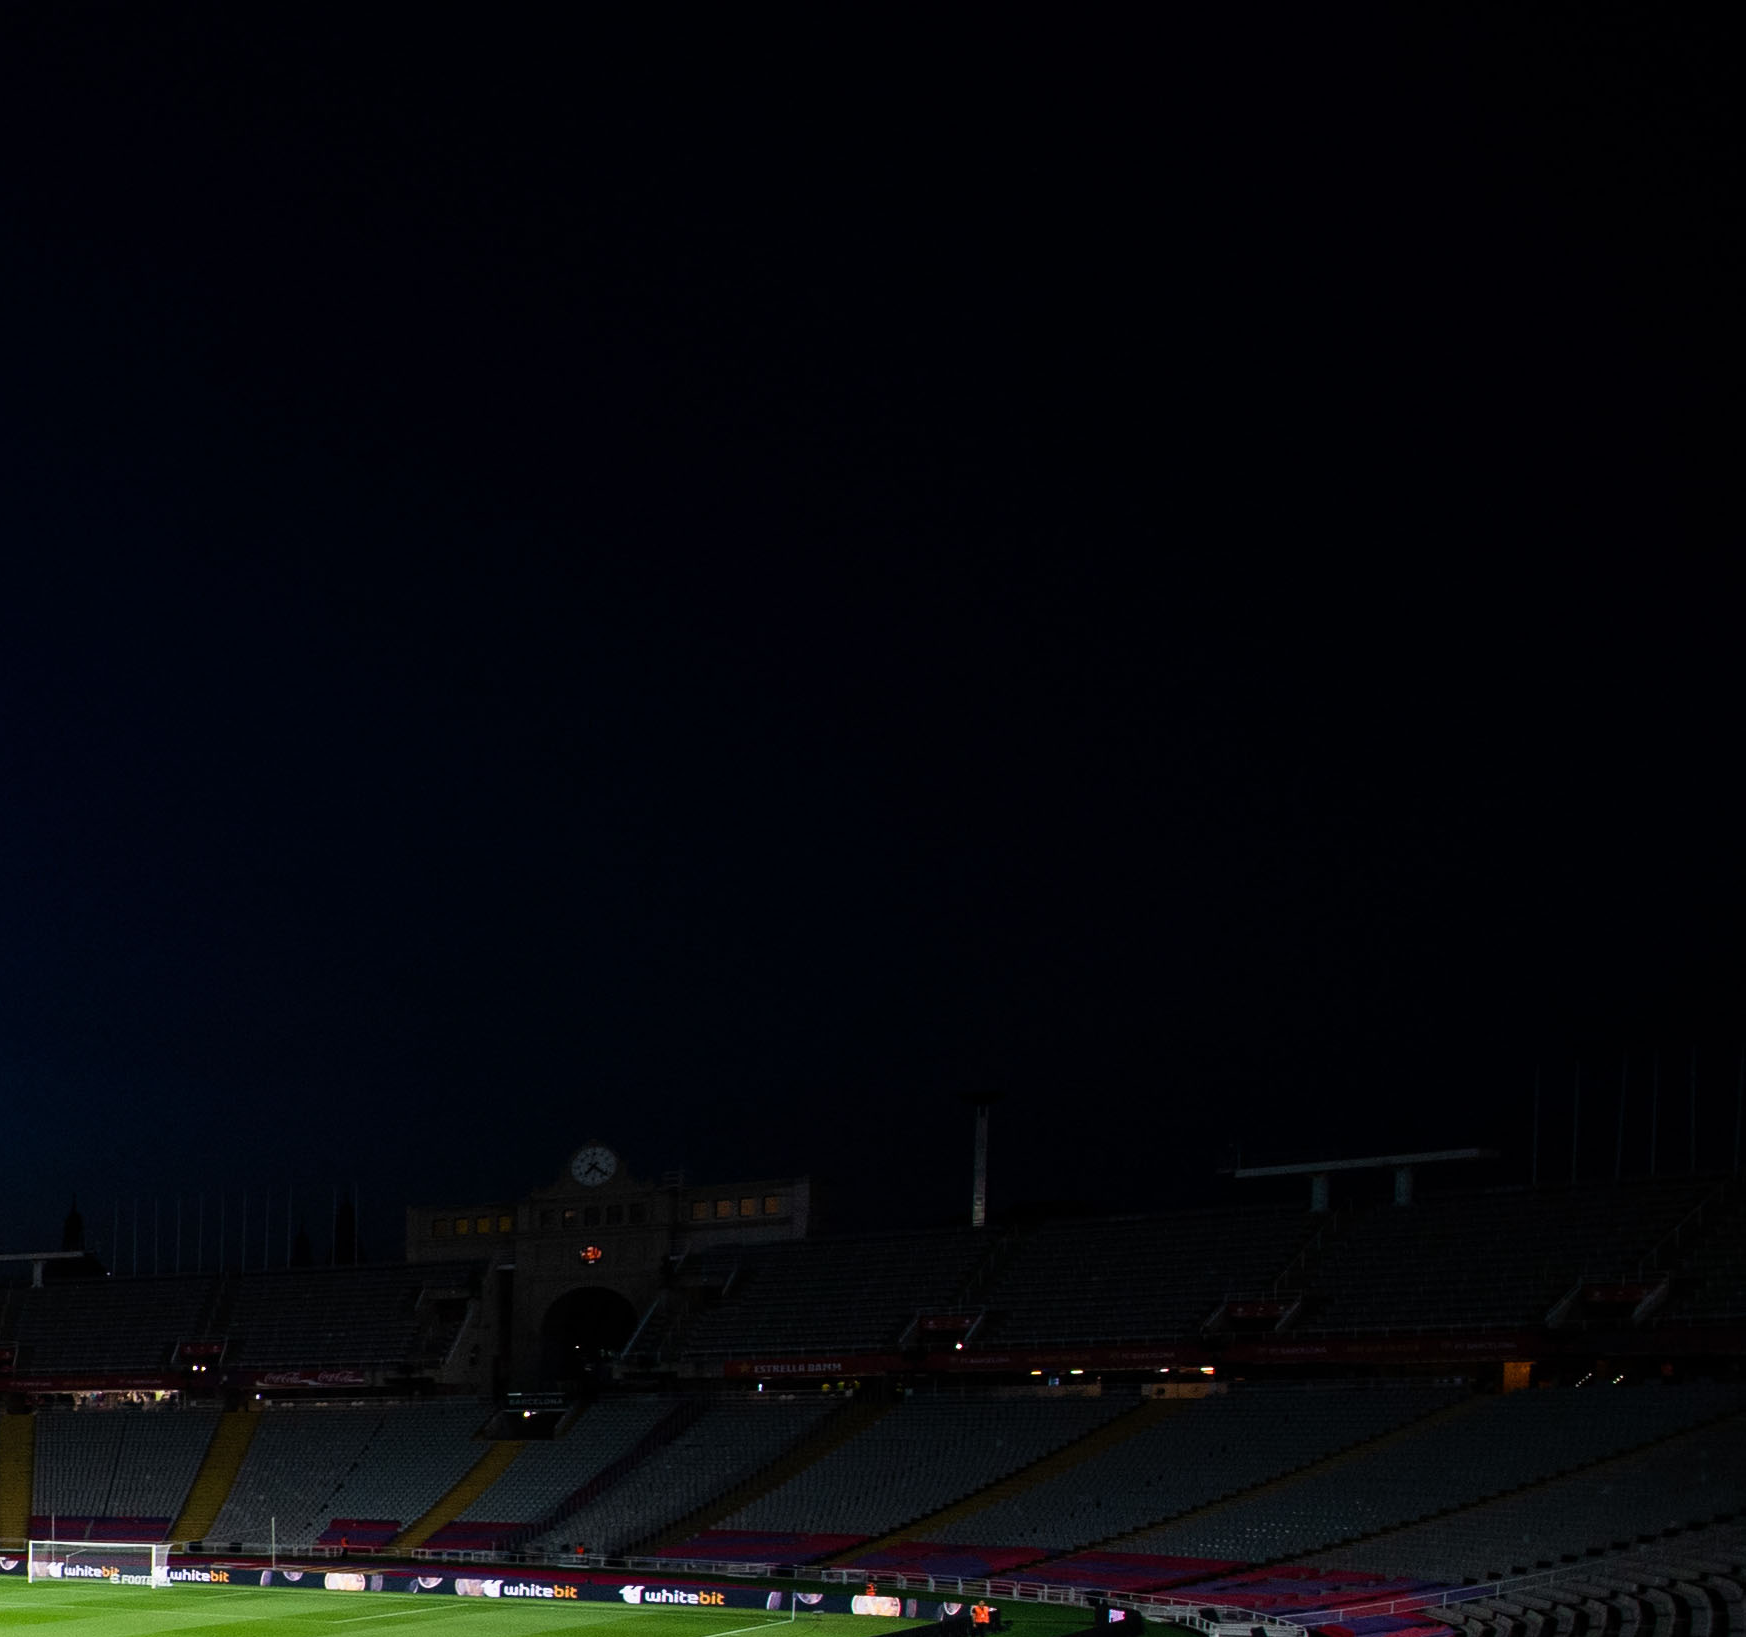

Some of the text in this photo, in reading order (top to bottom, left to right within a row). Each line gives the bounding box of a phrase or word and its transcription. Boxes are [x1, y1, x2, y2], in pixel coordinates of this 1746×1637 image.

[754, 1363, 842, 1374] ESTRELLA DAMM
[64, 1565, 119, 1577] whitebit
[170, 1569, 230, 1582] whitebit
[504, 1583, 578, 1599] whitebit
[644, 1589, 725, 1605] whitebit
